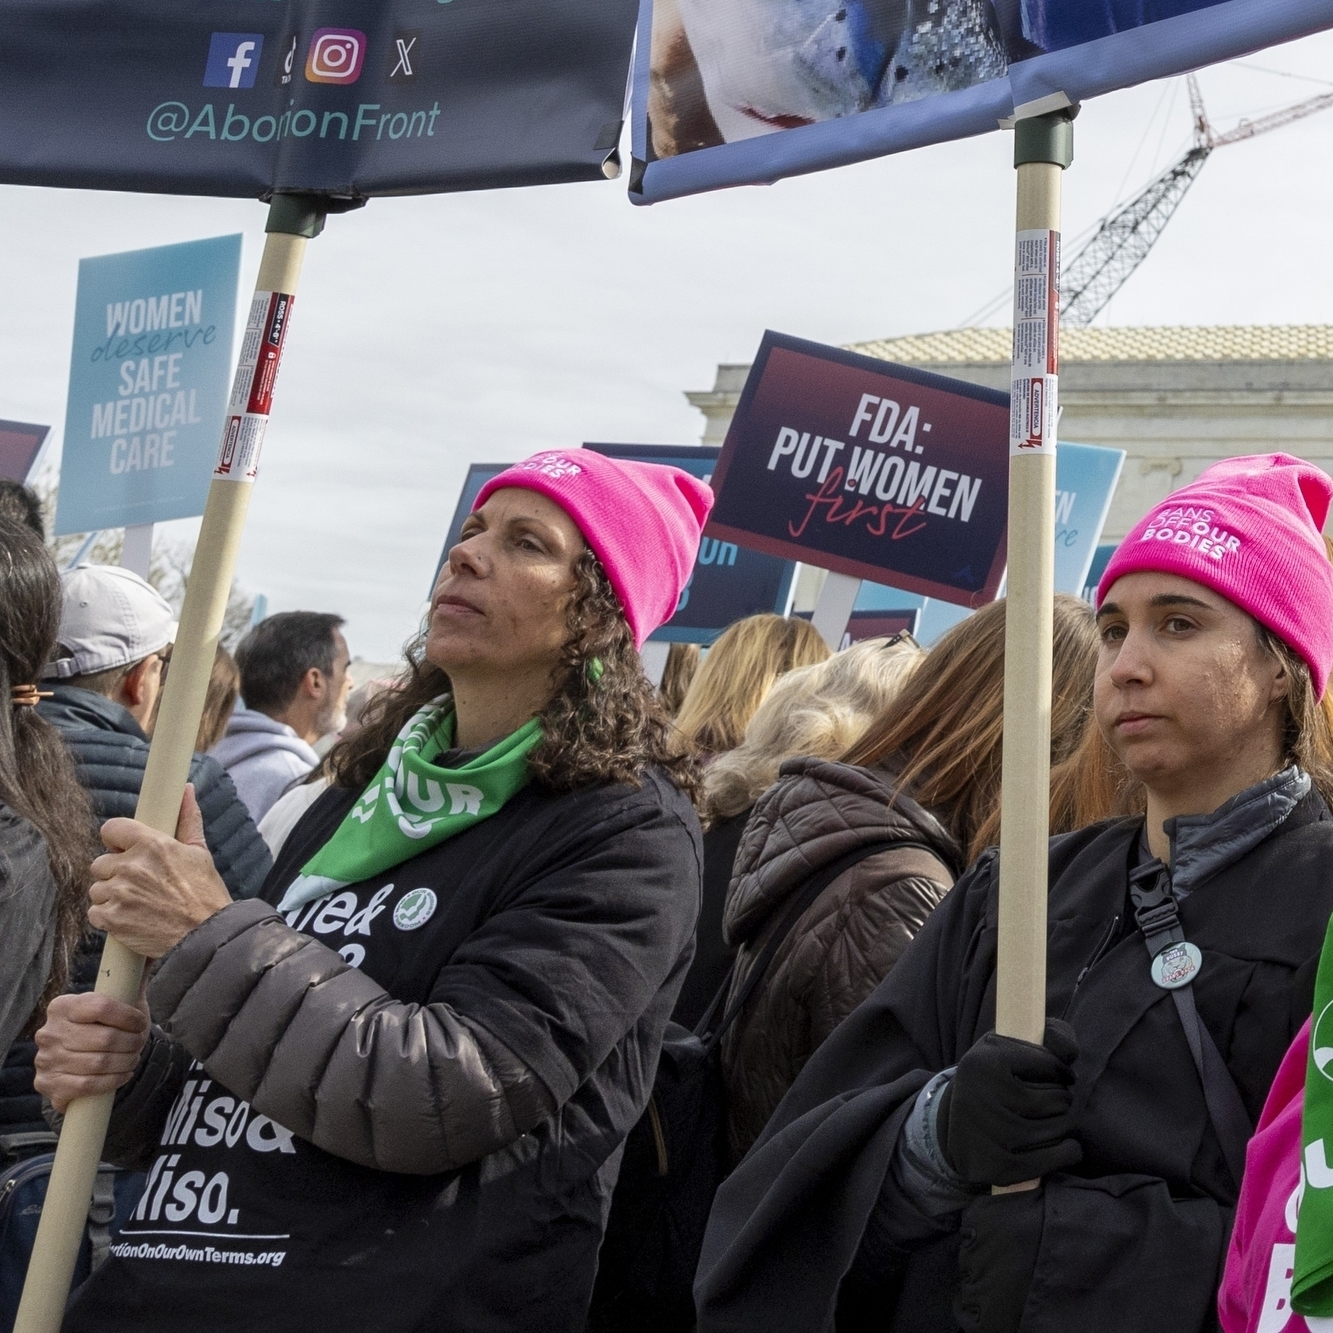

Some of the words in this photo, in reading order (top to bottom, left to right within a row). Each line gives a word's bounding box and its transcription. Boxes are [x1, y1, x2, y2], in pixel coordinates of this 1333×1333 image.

[106, 289, 203, 337] WOMEN
[90, 322, 217, 363] deserve
[118, 353, 183, 396] SAFE
[91, 389, 201, 440] MEDICAL
[848, 393, 932, 454] FDA:
[109, 429, 175, 475] CARE
[767, 426, 845, 484] PUT
[844, 446, 982, 522] WOMEN
[789, 466, 926, 539] first
[1141, 527, 1226, 561] BODIES
[1191, 521, 1241, 553] OUR
